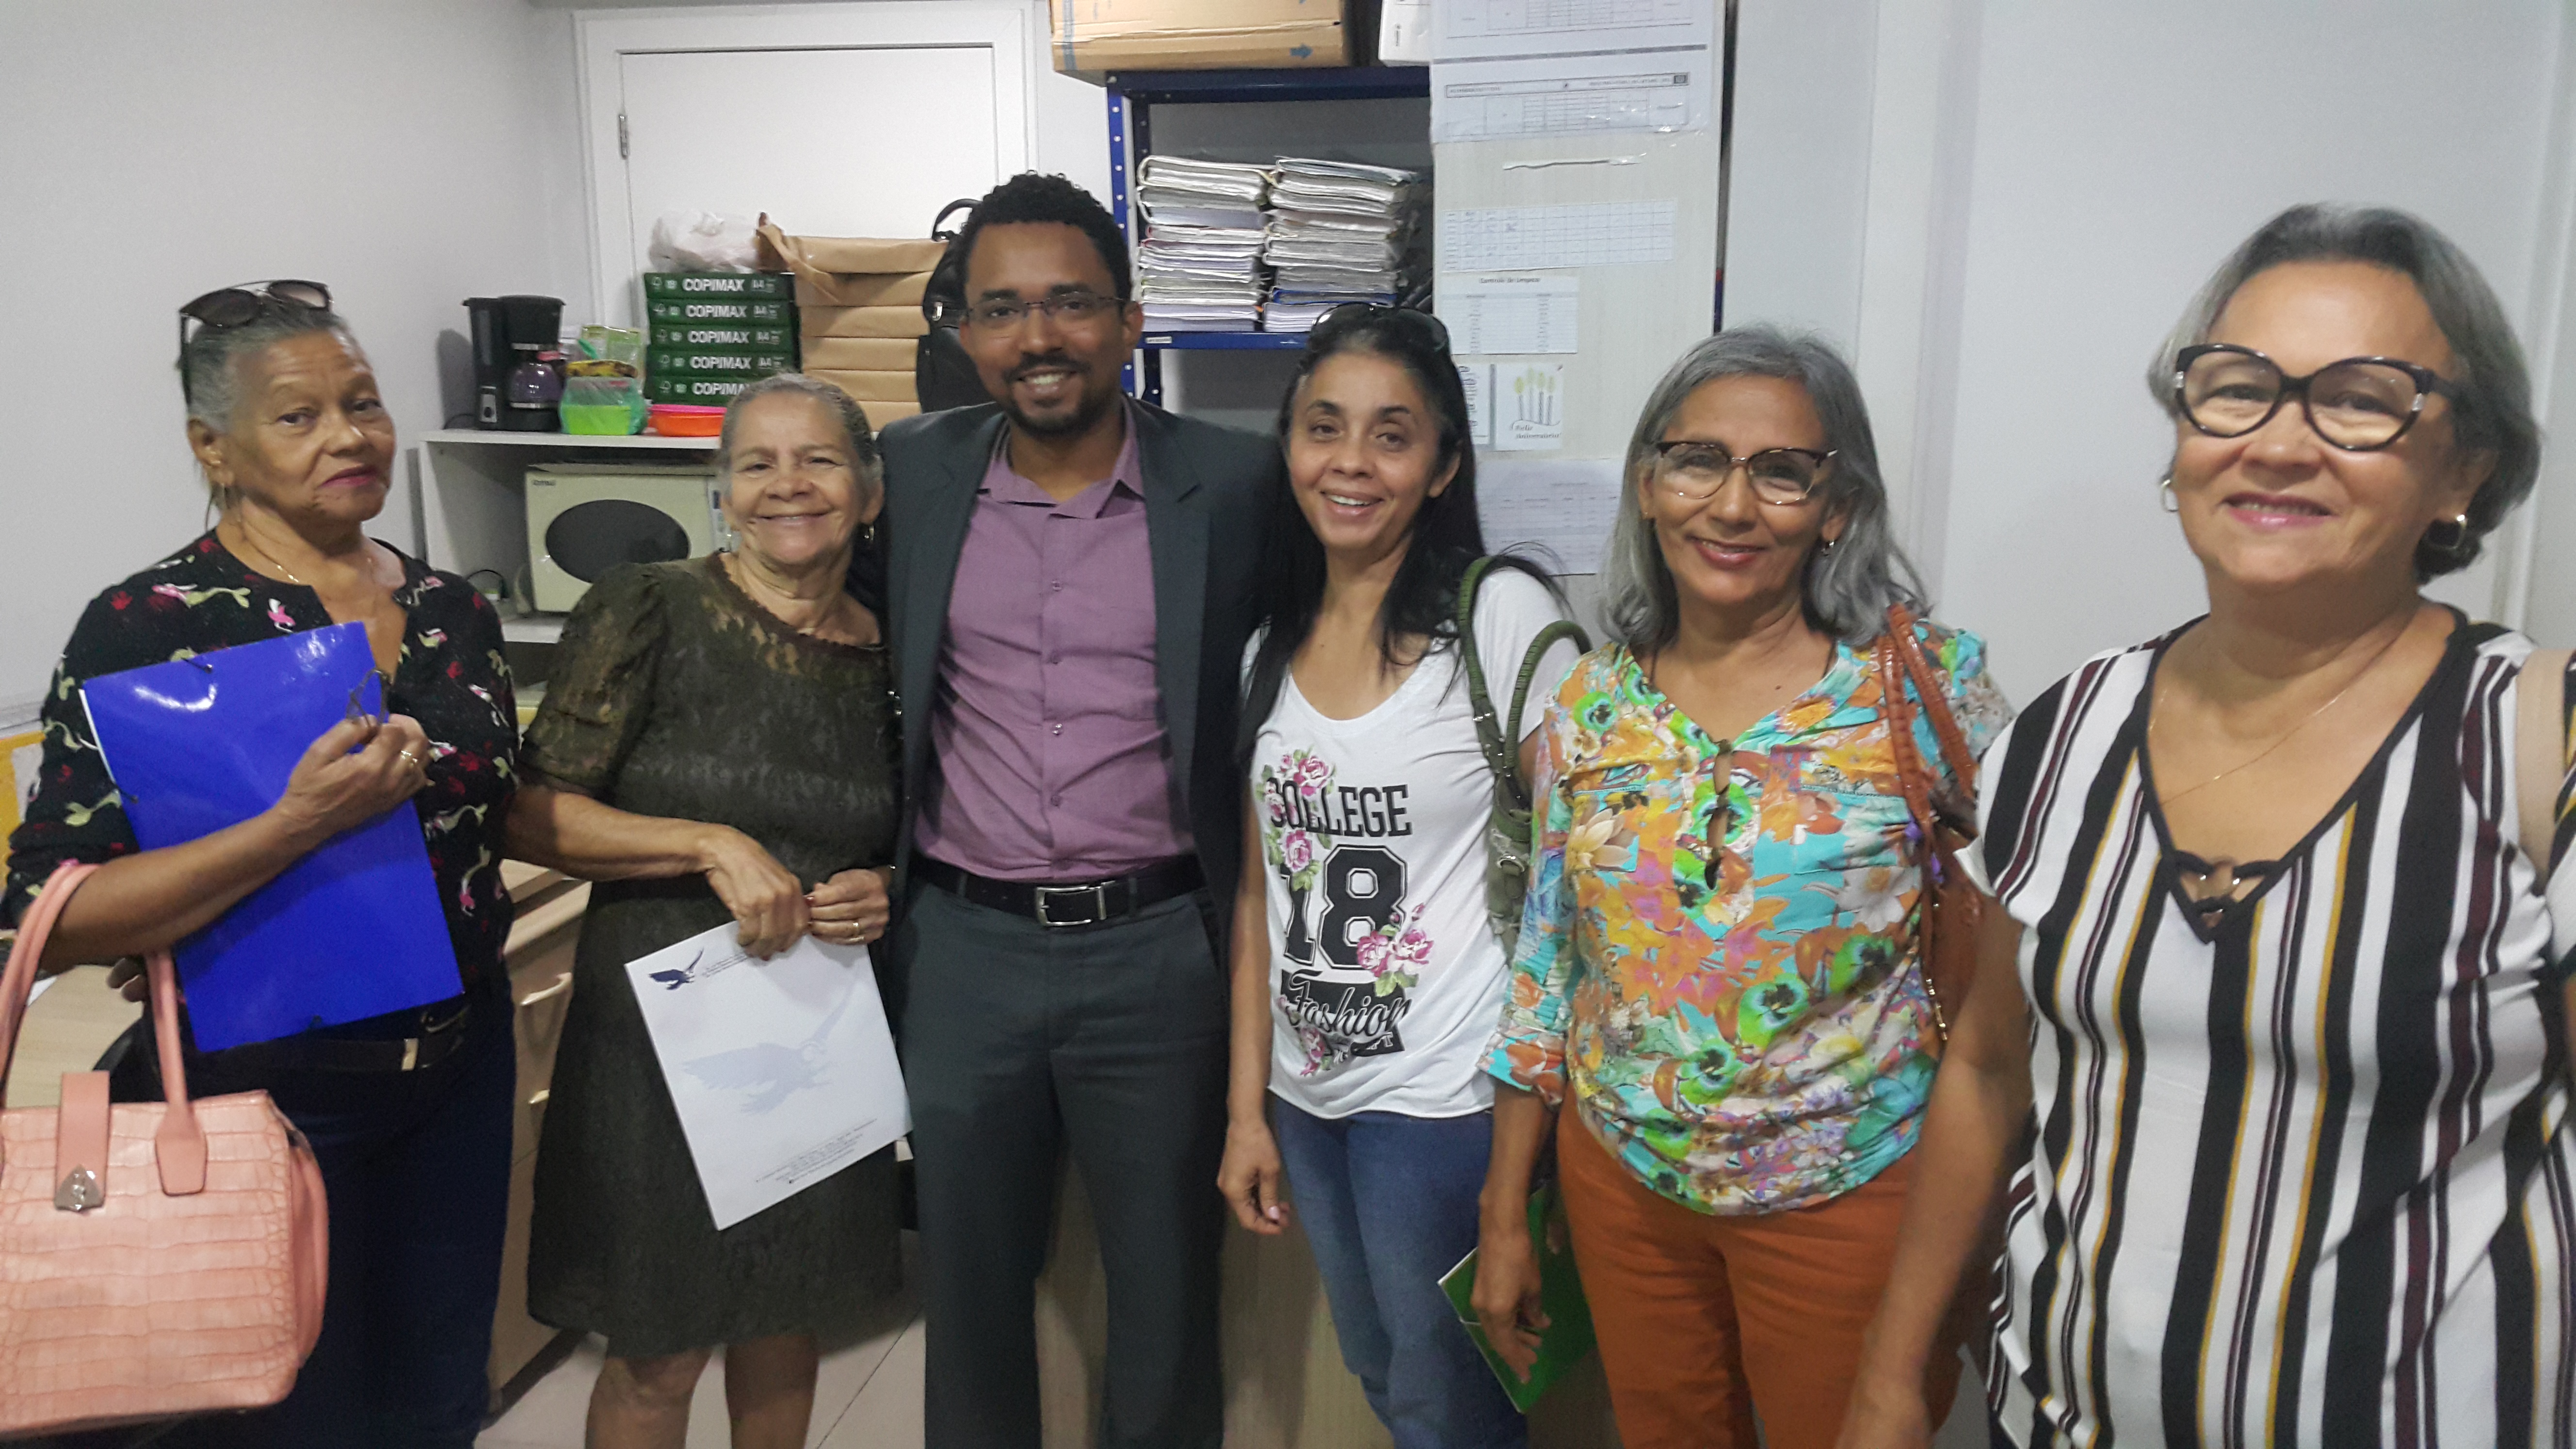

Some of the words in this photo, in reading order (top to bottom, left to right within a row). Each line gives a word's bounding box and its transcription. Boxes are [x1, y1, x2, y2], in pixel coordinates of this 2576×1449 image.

[682, 278, 745, 291] COPIMAX
[685, 305, 747, 317] COPIMAX
[688, 331, 750, 343] COPIMAX
[690, 356, 752, 369] COPIMAX
[692, 383, 750, 395] COPIMA
[1279, 844, 1408, 970] 18
[1286, 968, 1412, 1036] Fashion
